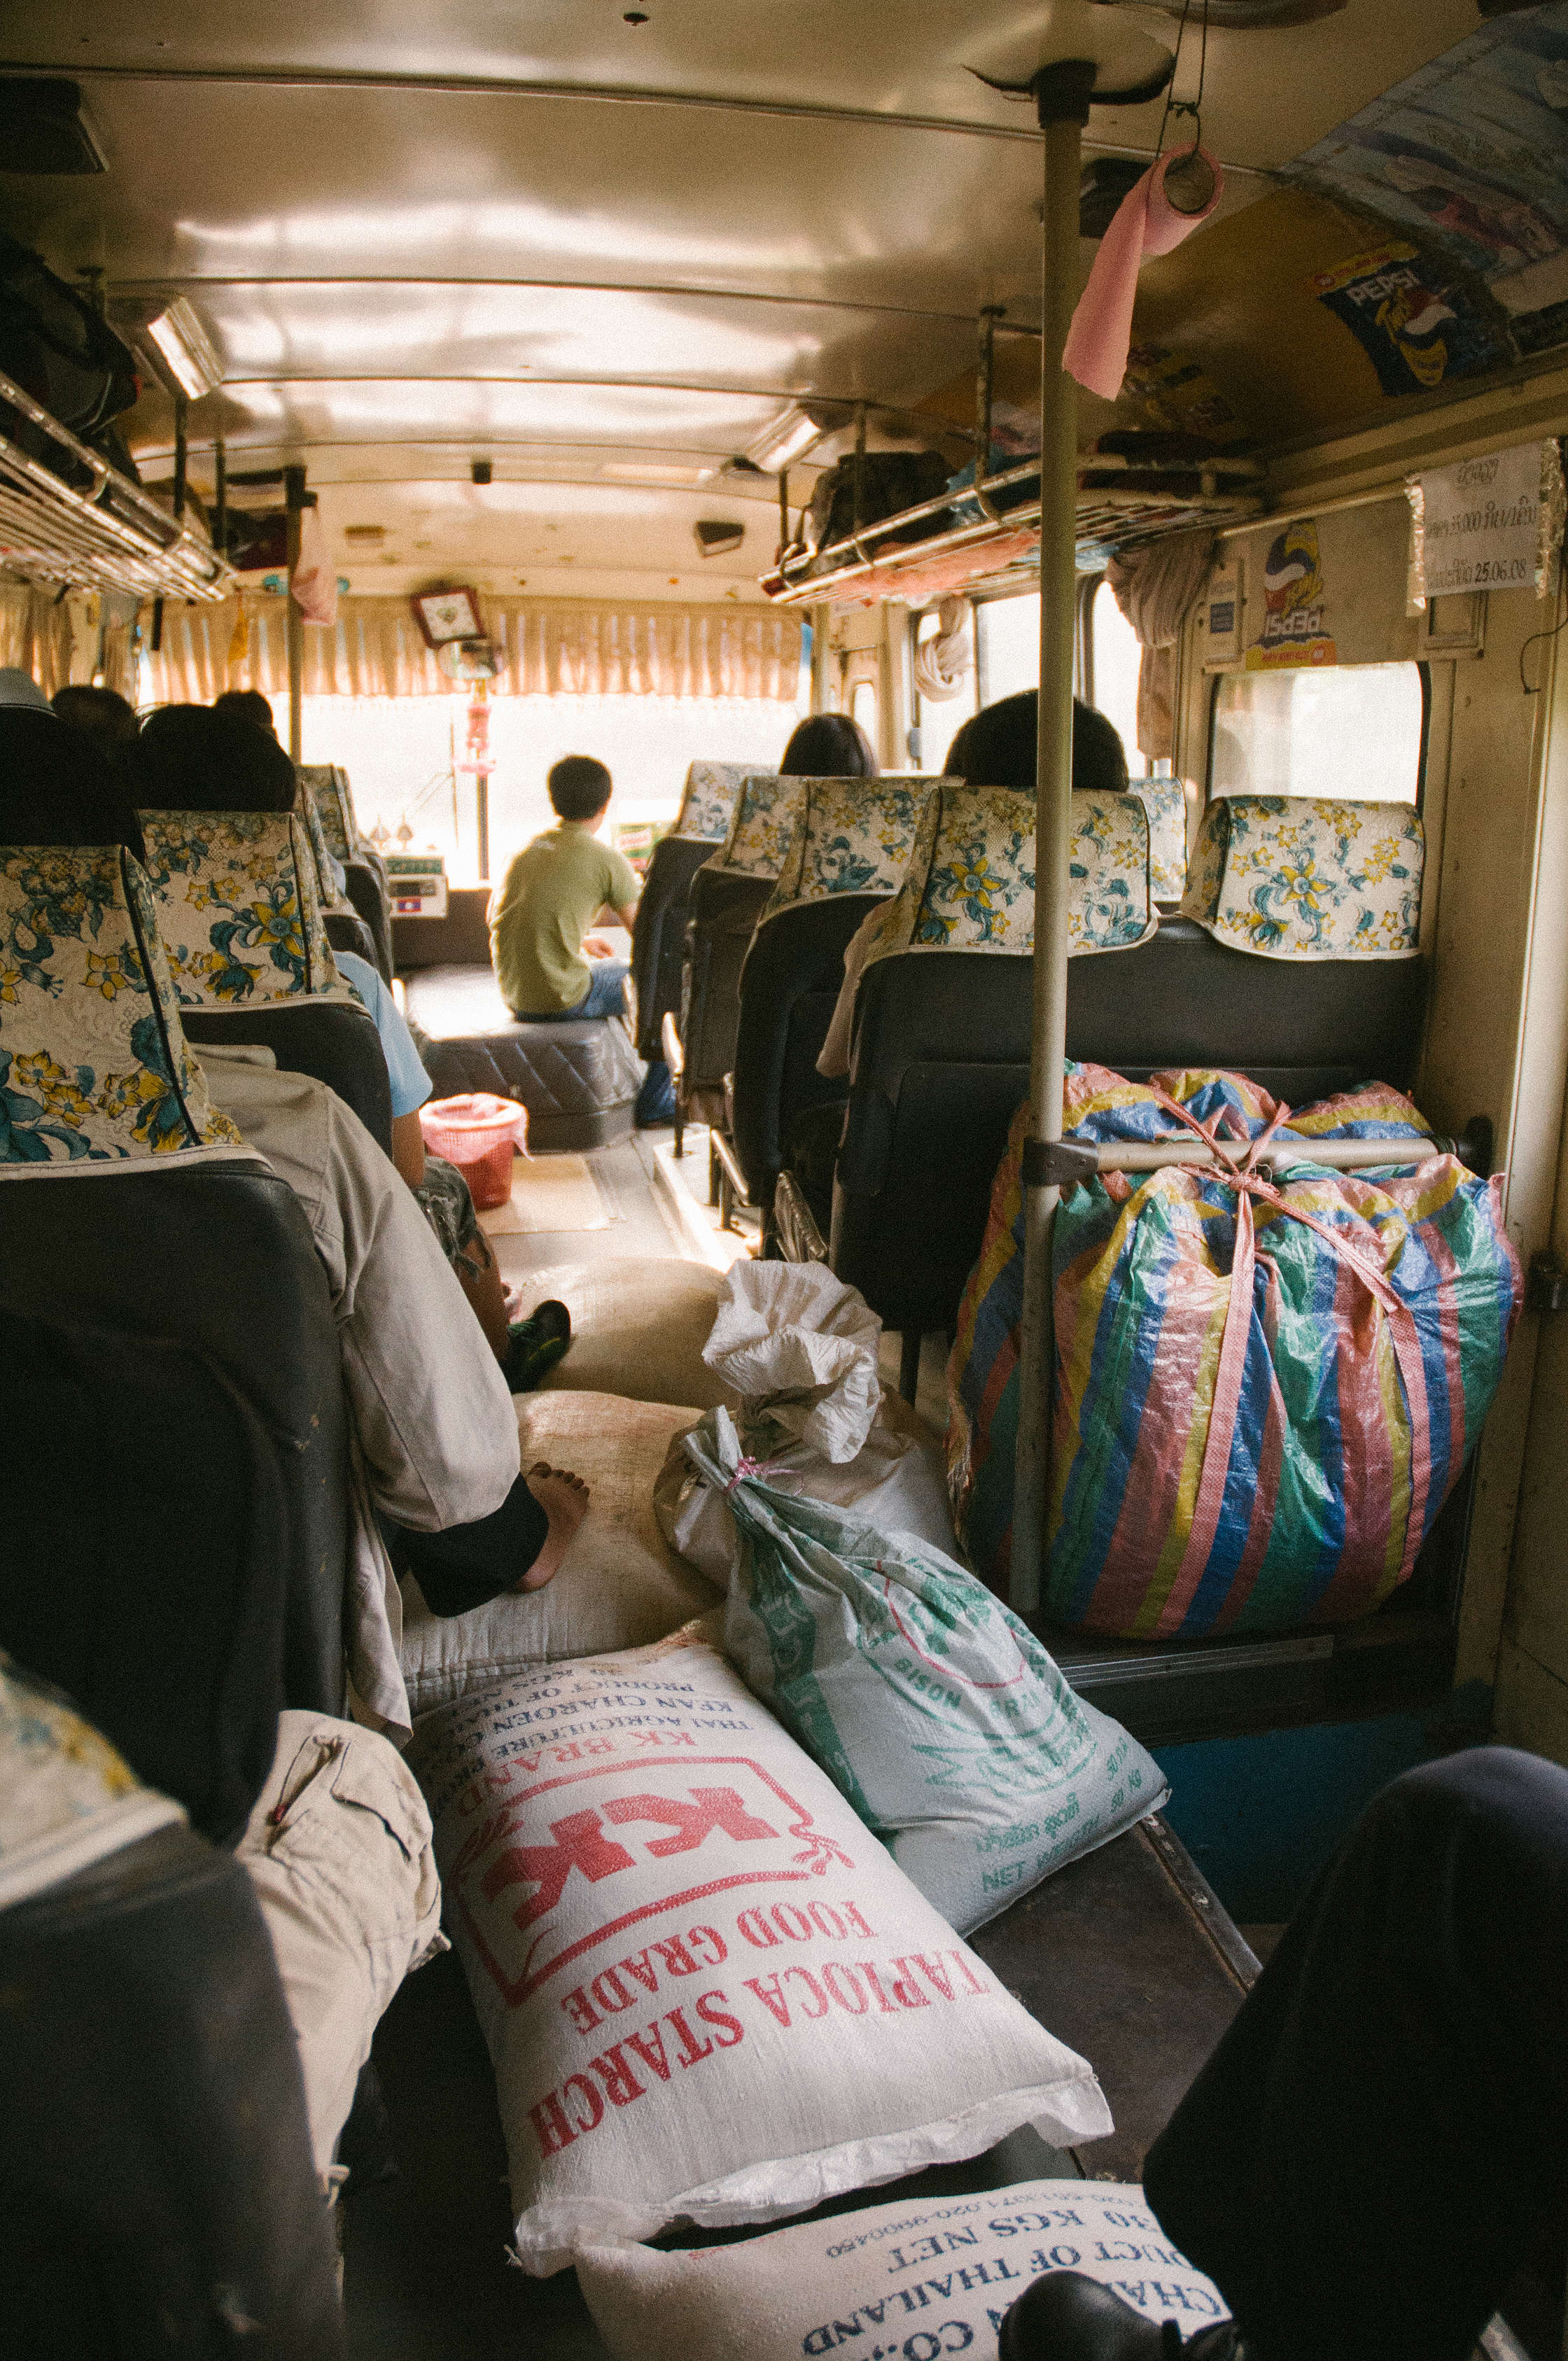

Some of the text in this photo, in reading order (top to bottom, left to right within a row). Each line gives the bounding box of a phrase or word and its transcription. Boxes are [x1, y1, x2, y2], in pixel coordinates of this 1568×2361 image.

[1346, 269, 1421, 307] PEPSI
[1265, 610, 1321, 636] PEPSI
[523, 1686, 561, 1702] OF
[570, 1681, 695, 1693] PRODUCT
[895, 1657, 962, 1710] BISON
[493, 1695, 648, 1736] CHAROEN
[493, 1714, 754, 1758] THAI AGRICULTURE
[629, 1729, 698, 1747] KK
[456, 1736, 617, 1817] BRAND
[480, 1786, 781, 1930] KK
[981, 1860, 1027, 1891] NET
[559, 1900, 877, 2036] FOOD GRADE
[525, 1946, 990, 2159] TAPIOCA STARCH
[988, 2208, 1085, 2239] KGS
[887, 2226, 981, 2275] NET
[801, 2240, 1197, 2357] DUCT OF THAILAND
